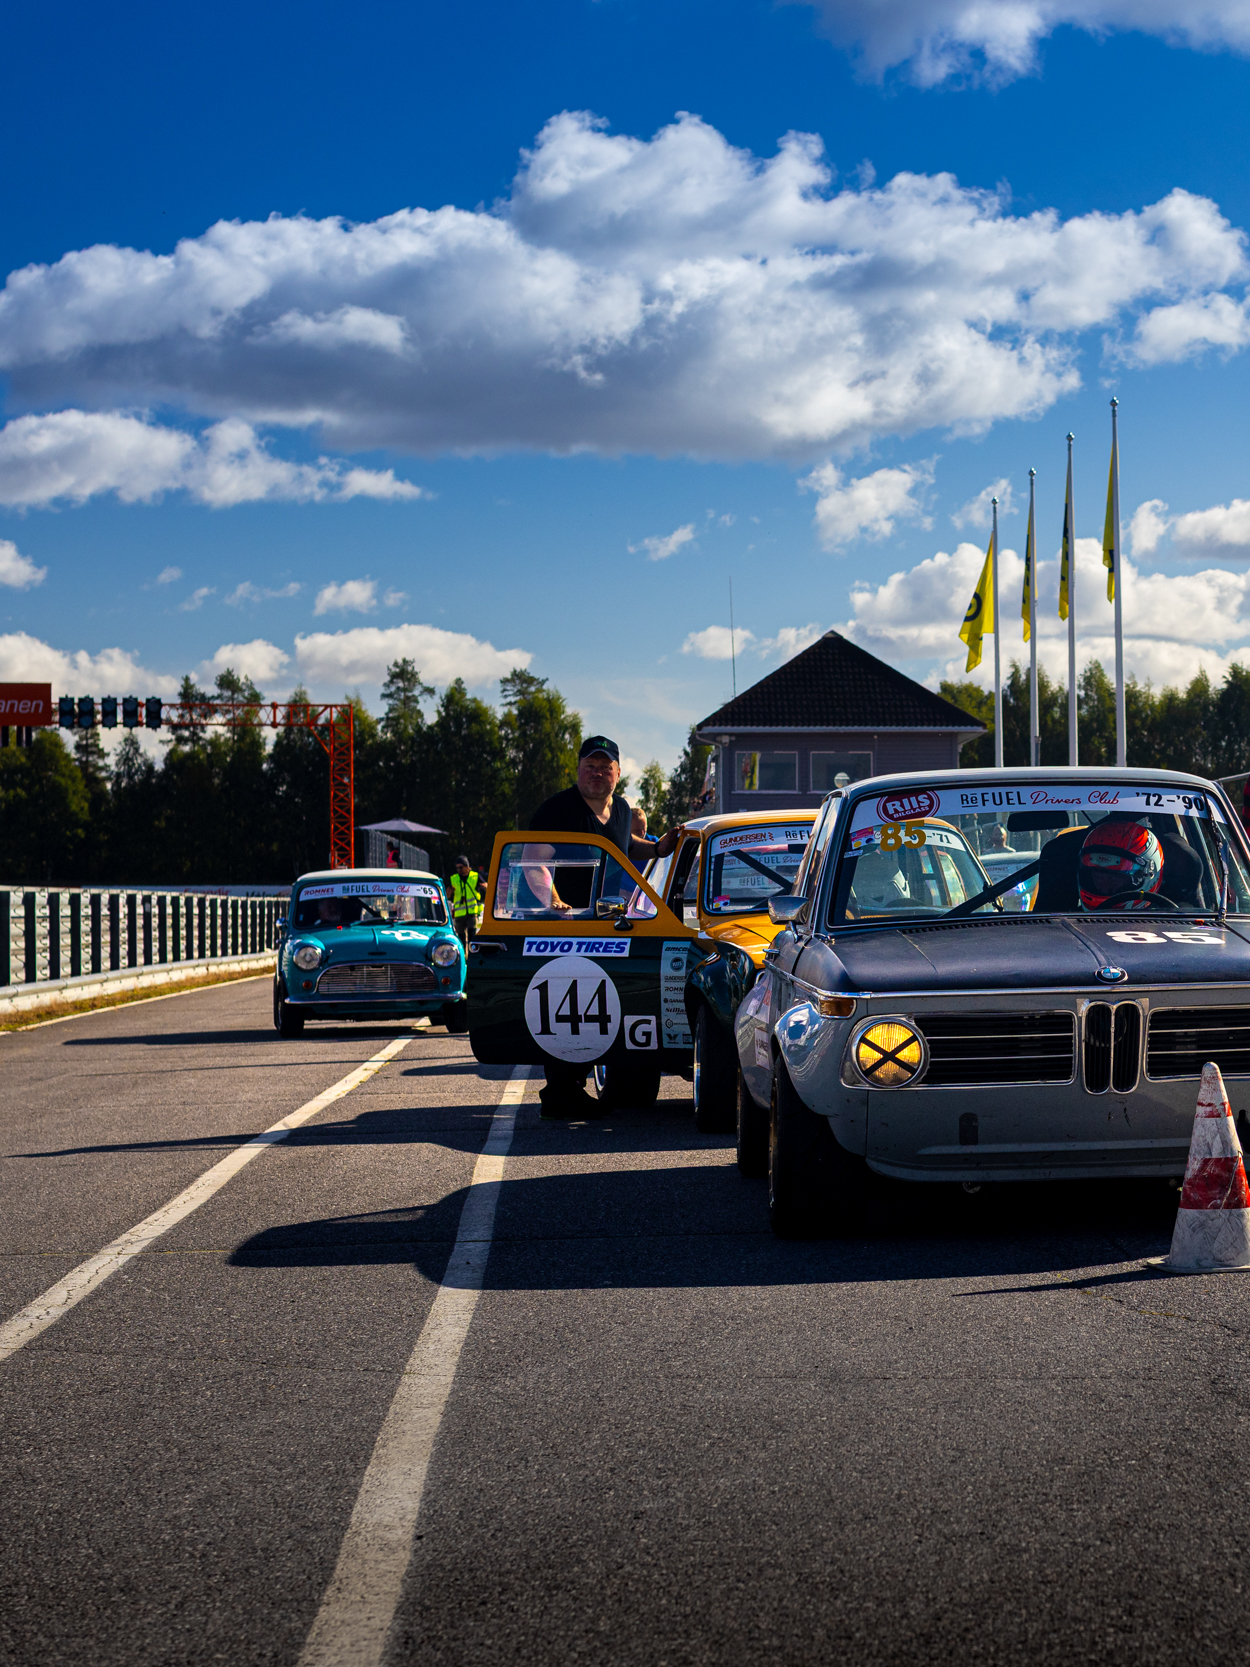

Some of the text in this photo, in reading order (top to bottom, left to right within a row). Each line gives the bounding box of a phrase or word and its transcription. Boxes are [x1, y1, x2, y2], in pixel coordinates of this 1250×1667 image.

[885, 794, 931, 815] RIIS
[1030, 790, 1082, 805] Drivers
[1087, 790, 1120, 805] Club
[893, 805, 930, 819] BILGLASS
[719, 832, 767, 846] GUNDERSEN
[879, 820, 927, 852] 85
[396, 884, 411, 894] Club
[1105, 930, 1226, 945] 85
[526, 940, 628, 954] TOYO TIRES
[531, 979, 612, 1036] 144
[628, 1018, 653, 1048] G
